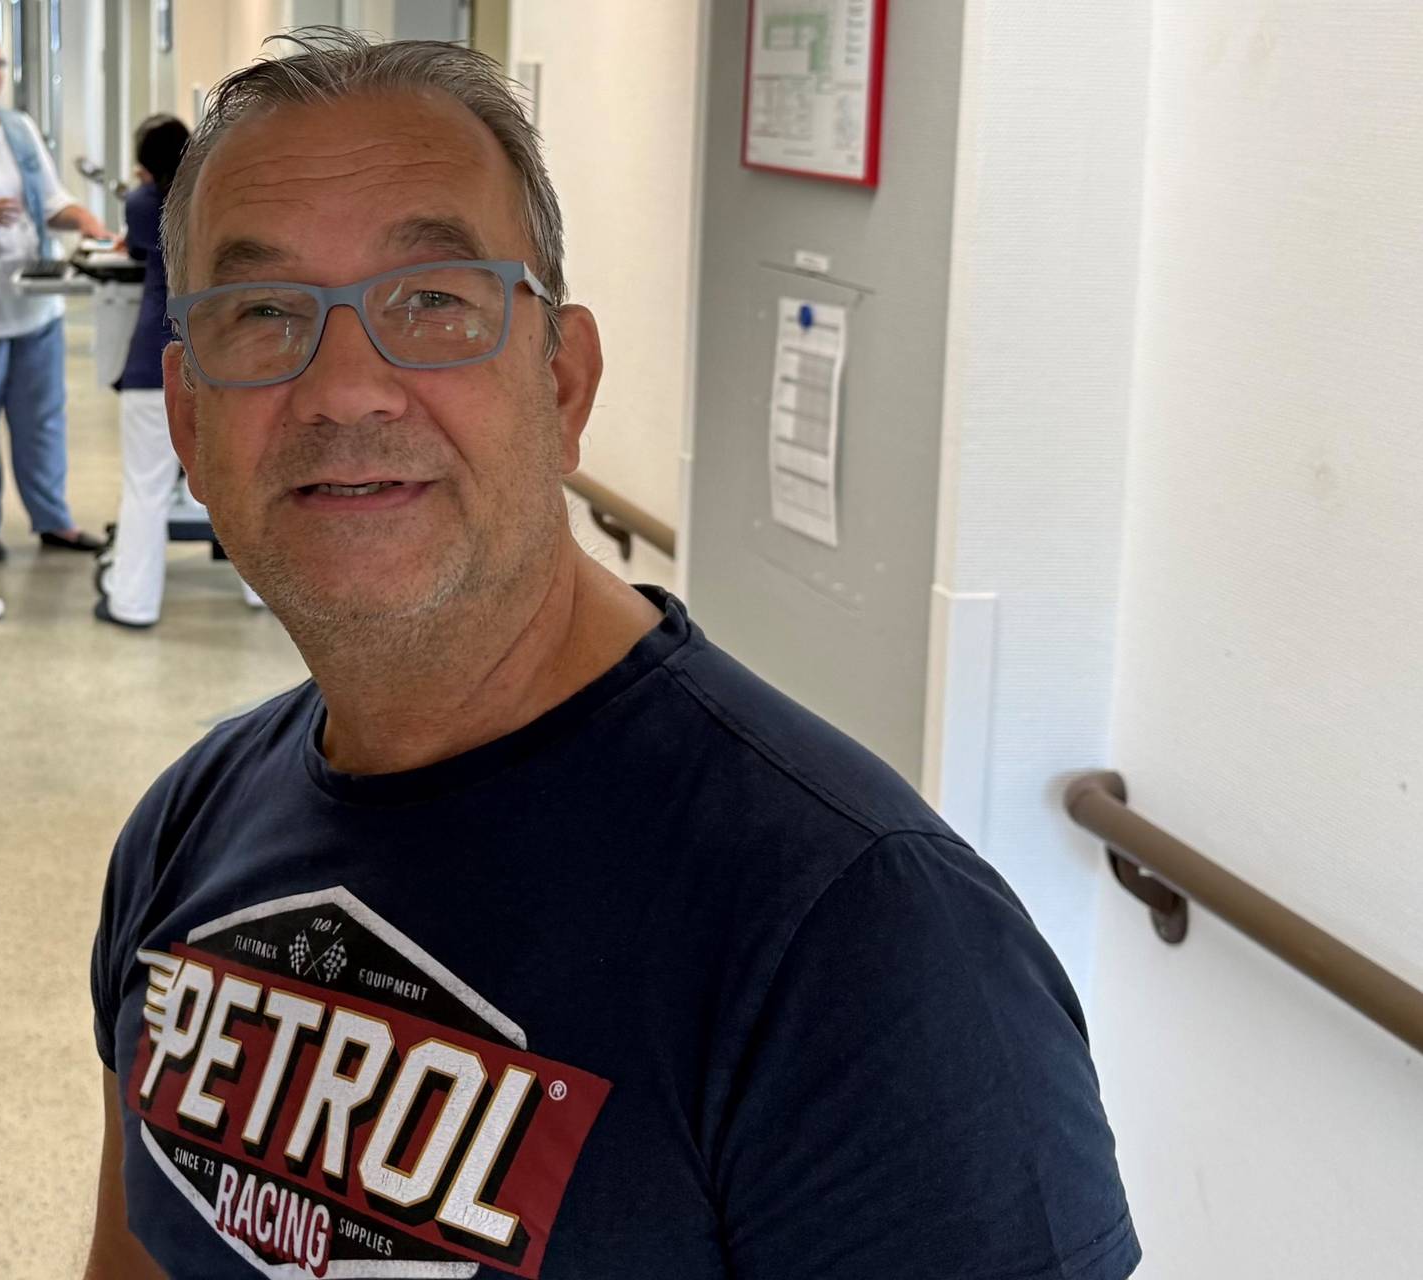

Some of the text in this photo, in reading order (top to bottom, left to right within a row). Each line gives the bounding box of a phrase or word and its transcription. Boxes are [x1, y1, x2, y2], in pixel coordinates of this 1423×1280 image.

[358, 968, 428, 1001] EQUIPMENT
[138, 953, 541, 1248] PETROL
[173, 1147, 199, 1170] SINCE
[214, 1163, 331, 1268] RACING
[338, 1217, 393, 1256] SUPPLIES
